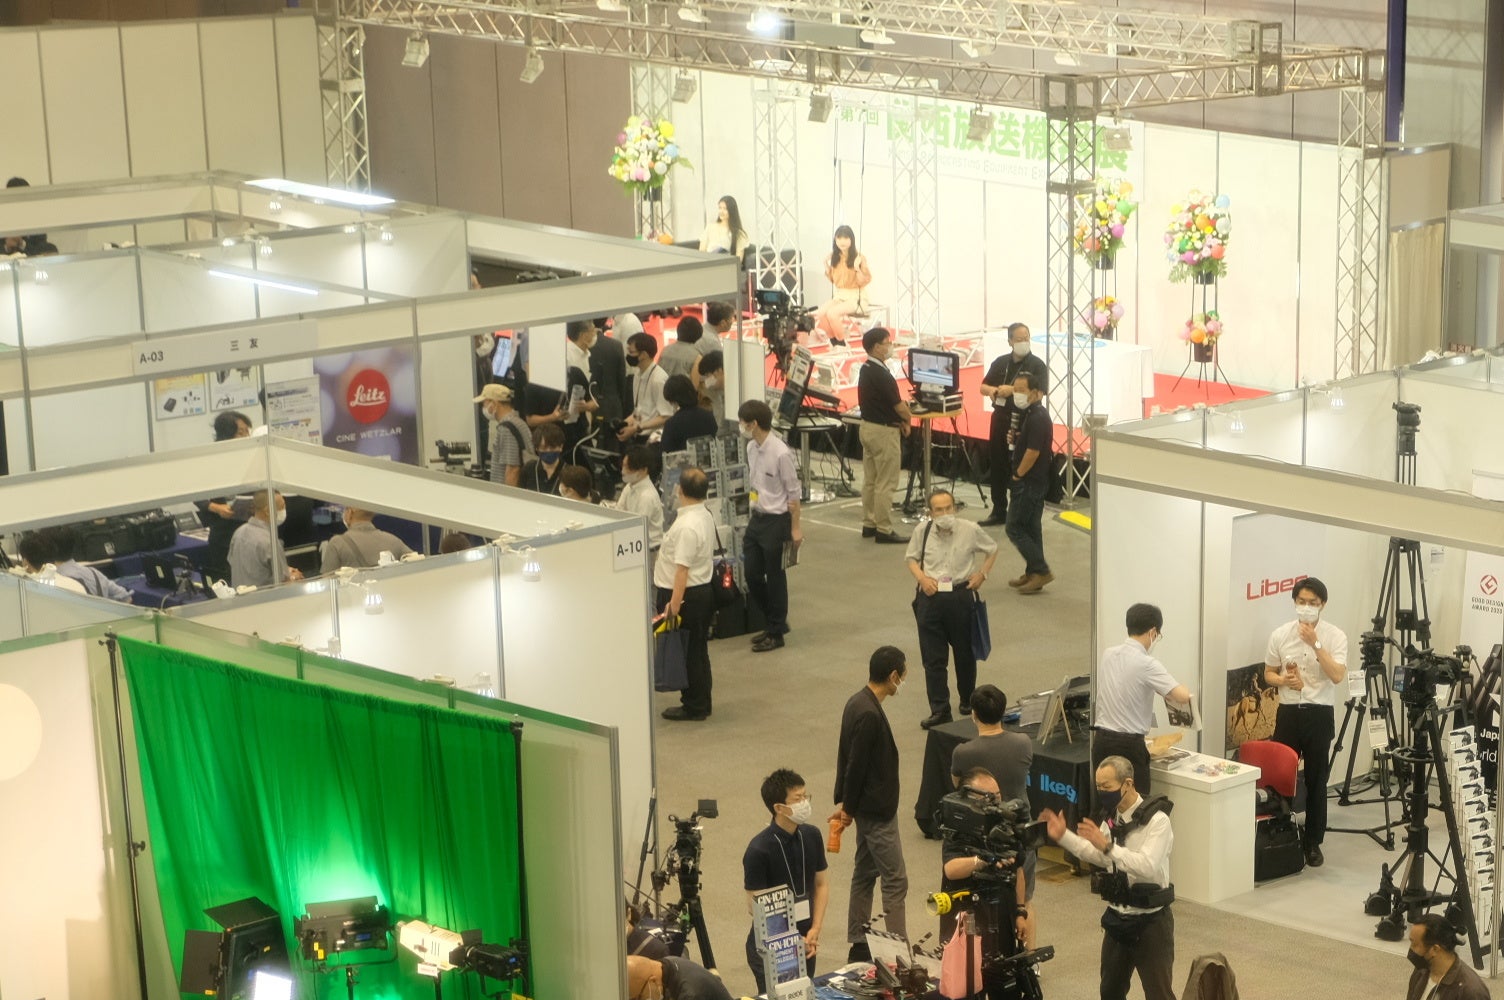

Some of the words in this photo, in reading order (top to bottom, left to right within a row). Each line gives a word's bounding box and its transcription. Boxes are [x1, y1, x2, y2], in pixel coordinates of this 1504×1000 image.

[139, 351, 165, 365] A-03
[350, 385, 387, 408] Leitz
[336, 431, 356, 443] CINE
[359, 427, 402, 440] WETZLAR
[616, 539, 643, 557] A-10
[1040, 773, 1078, 804] Ikeg
